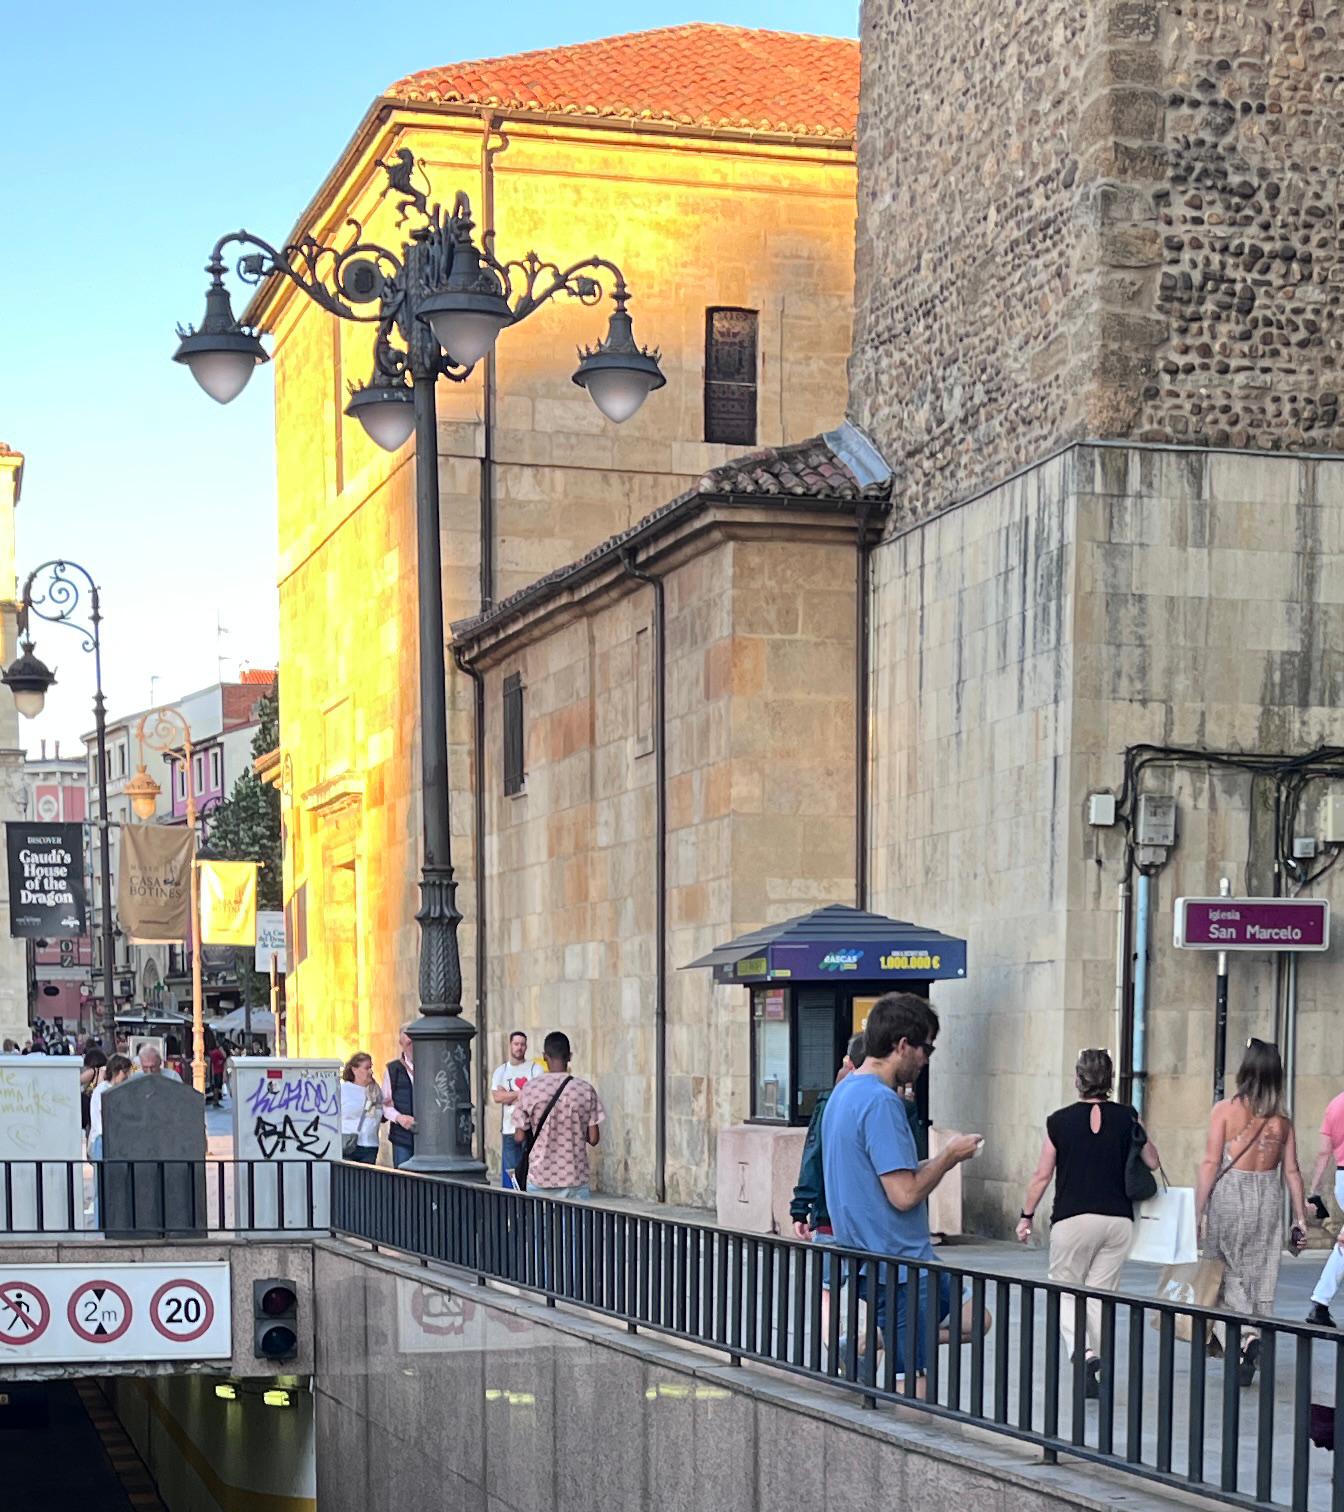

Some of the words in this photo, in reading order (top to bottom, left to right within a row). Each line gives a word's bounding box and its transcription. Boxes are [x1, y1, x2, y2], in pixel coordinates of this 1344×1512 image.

[27, 836, 62, 845] DISCOVER
[23, 864, 68, 877] House
[25, 877, 41, 890] of
[43, 876, 67, 890] the
[129, 876, 161, 886] CASA
[20, 889, 74, 907] Dragon
[129, 887, 182, 899] BOTINES
[1208, 924, 1236, 940] San
[1246, 925, 1302, 940] Marcelo
[932, 956, 941, 970] €
[165, 1298, 201, 1323] 20
